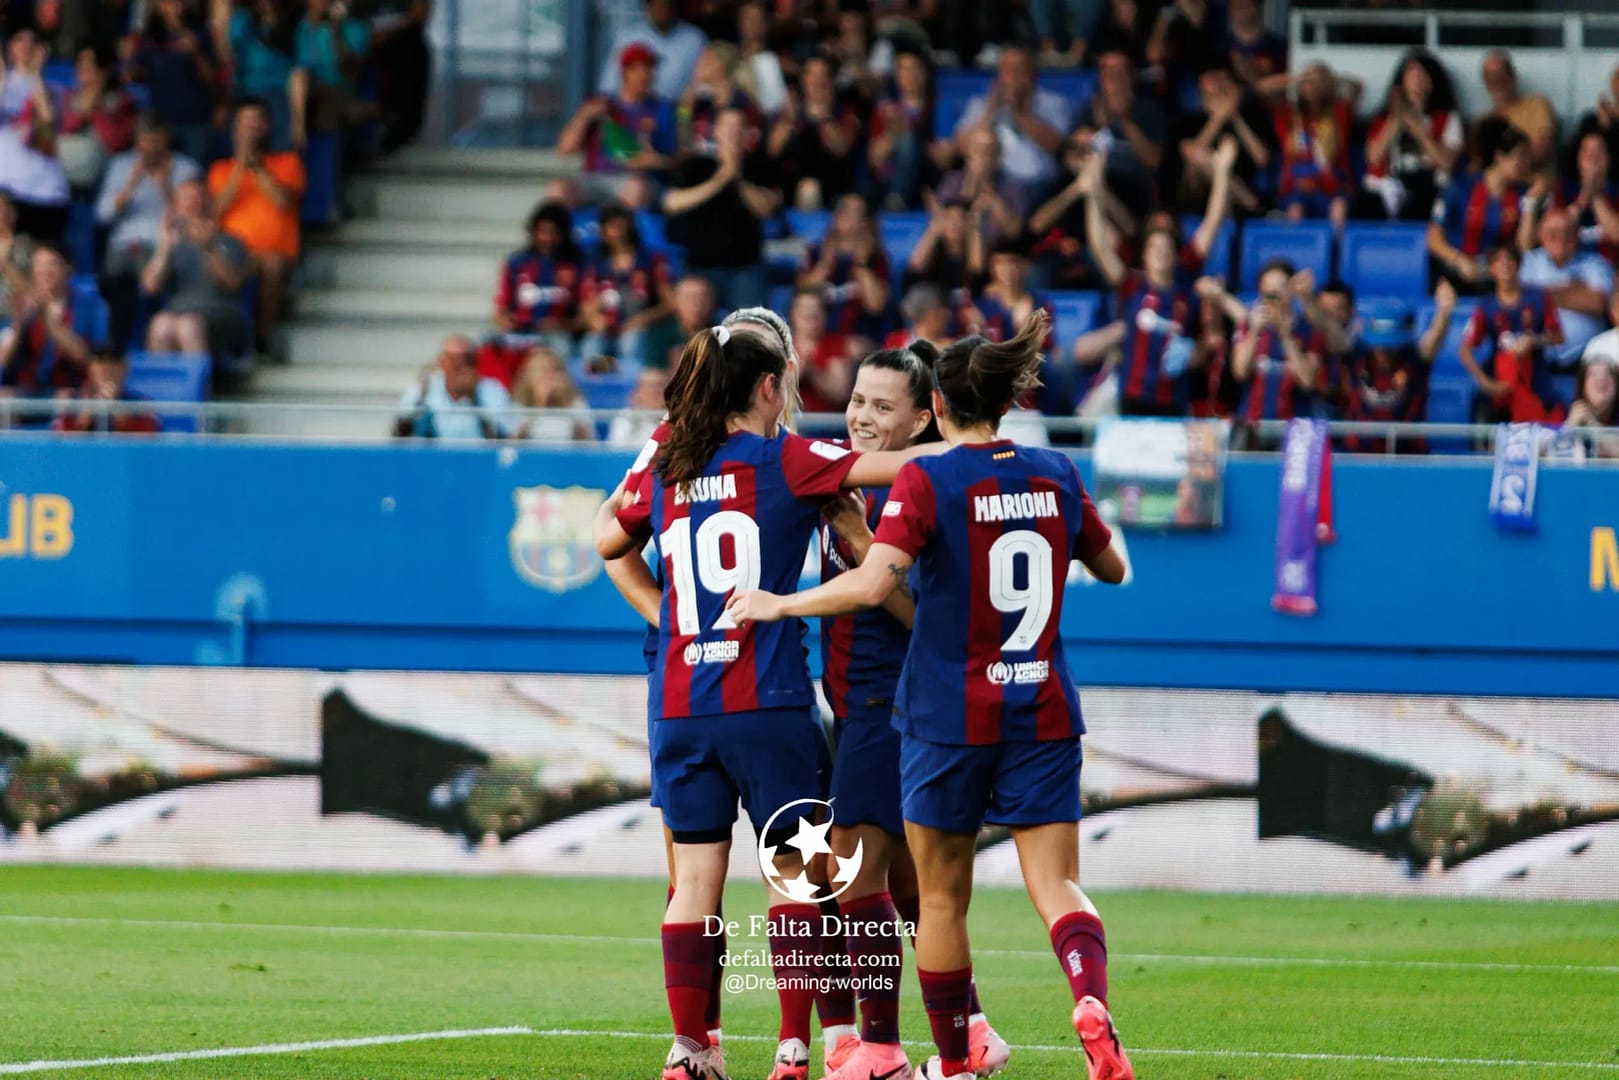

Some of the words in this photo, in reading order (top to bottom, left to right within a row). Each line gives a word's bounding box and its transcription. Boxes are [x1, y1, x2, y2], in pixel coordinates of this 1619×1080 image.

[974, 491, 1059, 522] MARIONA
[660, 510, 761, 636] 19
[988, 530, 1053, 651] 9
